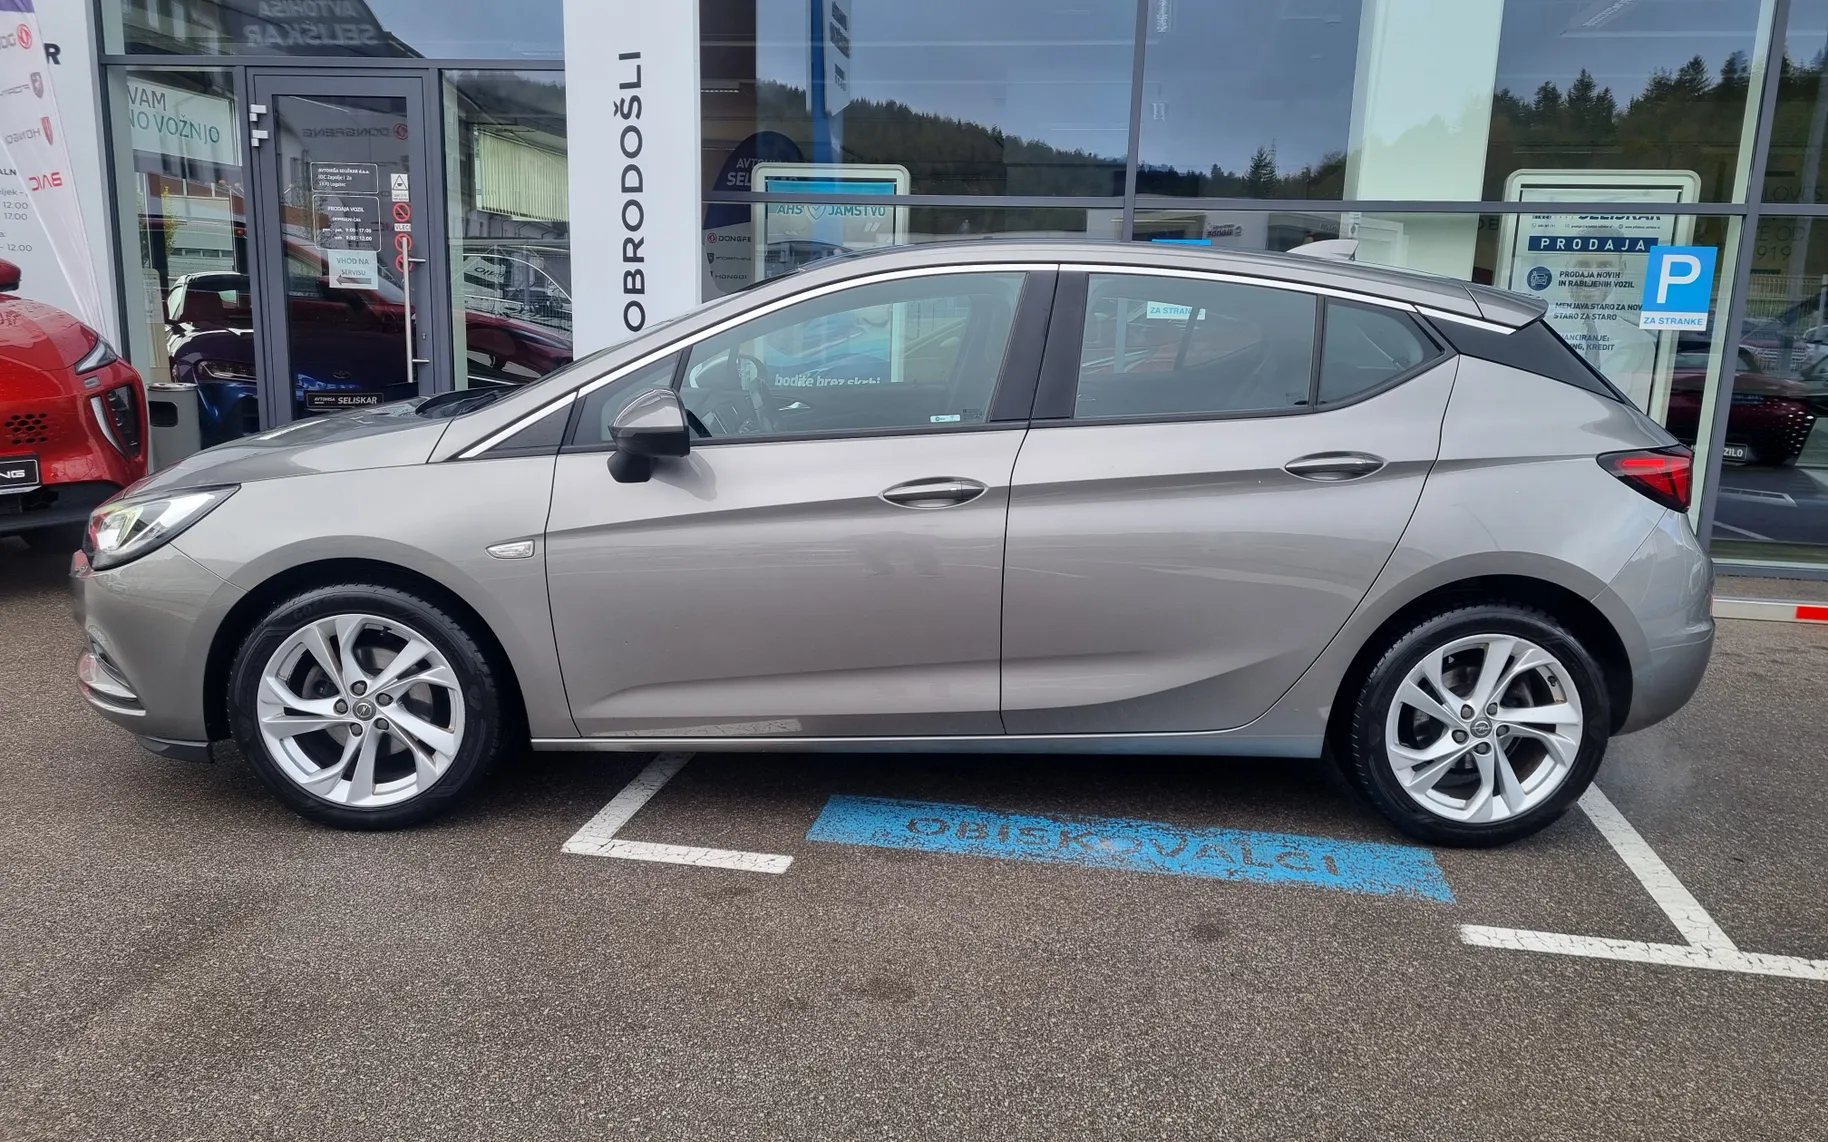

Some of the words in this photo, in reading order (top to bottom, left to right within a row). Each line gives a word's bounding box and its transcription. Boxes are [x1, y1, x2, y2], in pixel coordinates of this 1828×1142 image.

[127, 84, 167, 112] VAM
[153, 113, 220, 145] VOŽNJO
[613, 51, 646, 333] OBRODOŠLI
[828, 204, 886, 217] JAMSTVO
[1540, 237, 1646, 252] PRODAJA
[336, 257, 357, 265] VHOD
[1559, 270, 1595, 279] PRODAJA
[1596, 271, 1621, 279] NOVIH
[1656, 254, 1702, 304] P
[1568, 280, 1612, 288] RABLJENIH
[1554, 302, 1590, 310] MENJAVA
[1553, 312, 1579, 320] STARO
[1591, 313, 1618, 321] STARO
[1643, 316, 1656, 325] ZA
[1658, 317, 1704, 326] STRANKE
[337, 396, 378, 404] SELIŠKAR
[907, 816, 1339, 877] OBISKOVALCI
